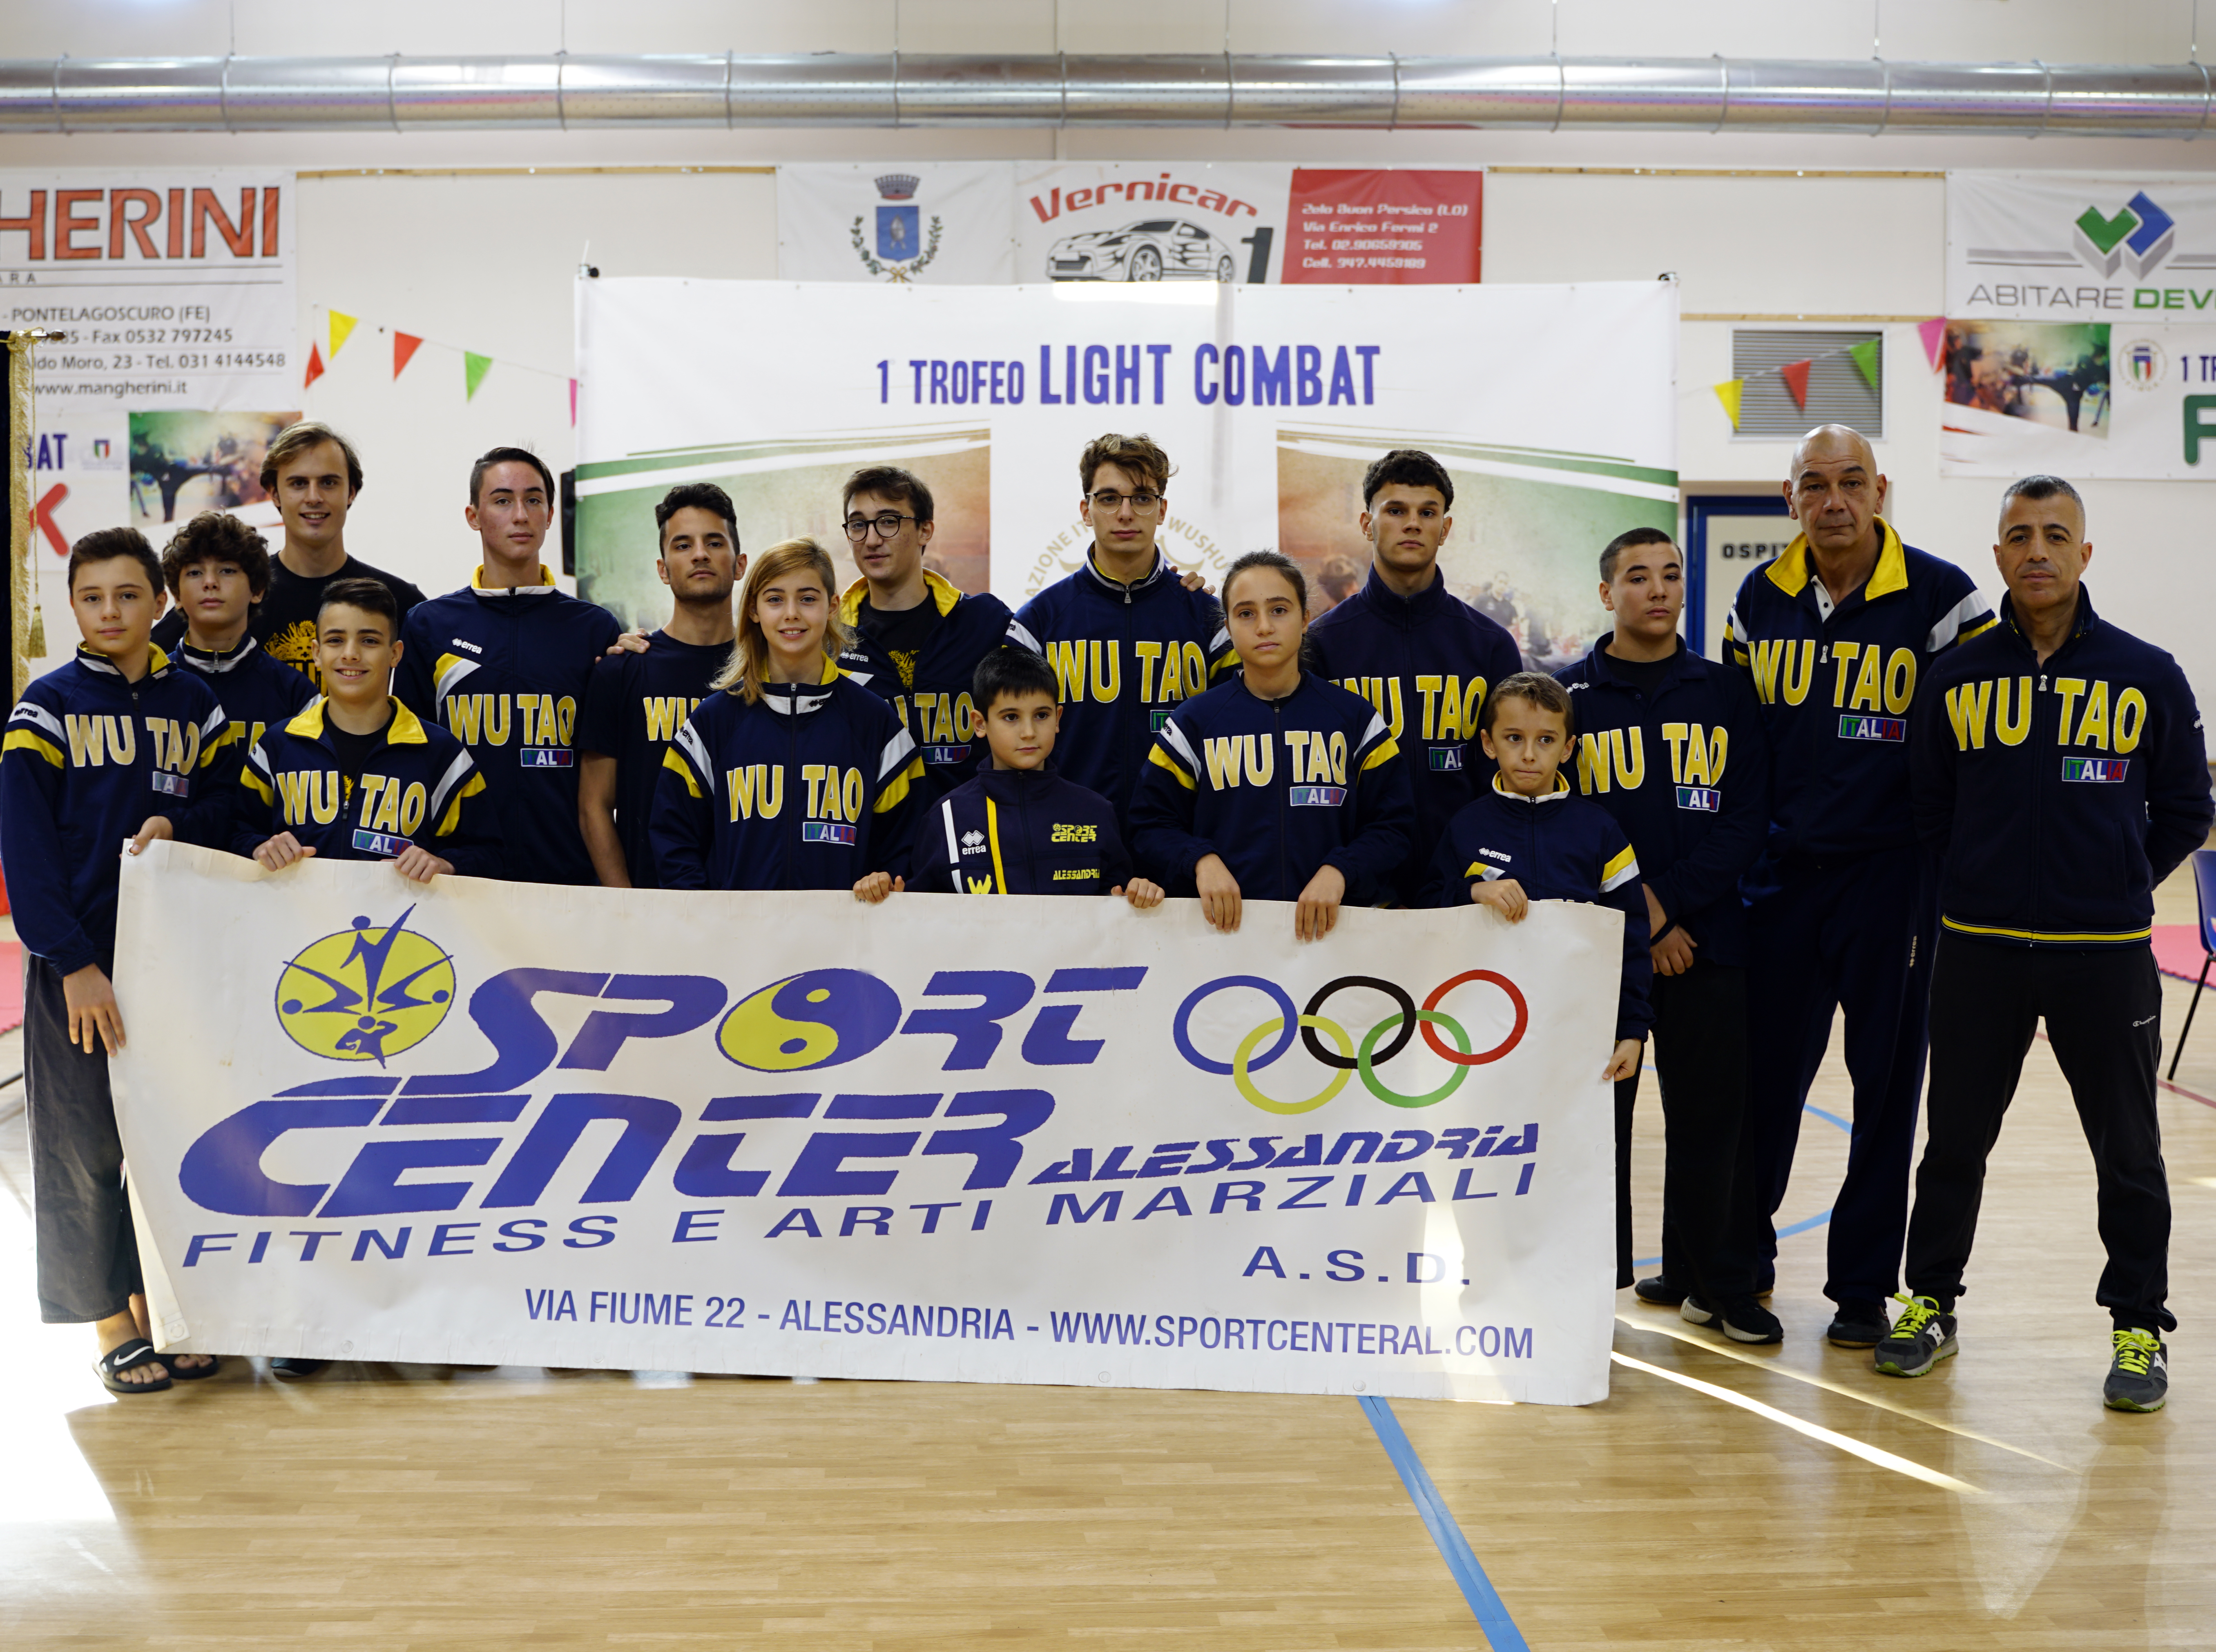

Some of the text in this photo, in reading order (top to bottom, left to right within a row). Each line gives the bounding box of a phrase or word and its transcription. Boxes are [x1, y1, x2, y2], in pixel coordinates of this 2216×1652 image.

[1029, 172, 1257, 223] Vernicar
[1301, 203, 1468, 216] Zelo Buon Persico (LO)
[1303, 221, 1439, 234] Via Enrico Fermi 2
[1303, 239, 1327, 250] Tel.
[0, 270, 36, 285] RA
[1241, 227, 1274, 283] 1
[1302, 257, 1332, 268] Cell.
[11, 306, 174, 322] PONTELAGOSCURO
[179, 305, 211, 324] (FE)
[1966, 284, 2216, 310] ABITARE DEV
[92, 330, 121, 344] Fax
[125, 329, 167, 344] 0532
[172, 328, 233, 343] 797245
[62, 355, 107, 371] Moro,
[112, 354, 133, 368] 23
[147, 354, 174, 369] Tel.
[179, 354, 208, 368] 031
[215, 353, 286, 367] 4144548
[909, 360, 1024, 404] TROFEO
[1040, 344, 1172, 405] LIGHT
[1194, 343, 1380, 406] COMBAT
[1024, 531, 1073, 604] AZIONE
[460, 639, 482, 654] errea
[850, 652, 869, 663] errea
[1046, 640, 1207, 703] WU TAO
[1747, 639, 1917, 715] WU TAO
[446, 693, 577, 747] WU TAO
[914, 691, 975, 743] TAO
[1415, 675, 1488, 740] TAO
[1842, 717, 1901, 740] ITALIA
[1945, 676, 2147, 754] WU TAO
[64, 714, 200, 776] WU TAO
[523, 750, 570, 766] ITALIA
[923, 747, 967, 762] ITALIA
[1203, 730, 1348, 791] WU TAO
[1576, 722, 1728, 796] WU TAO
[2065, 760, 2124, 781] ITALIA
[275, 769, 427, 836] WU TAO
[726, 764, 864, 823] WU TAO
[807, 824, 856, 844] ITALIA
[962, 844, 986, 855] errea
[1489, 849, 1512, 863] errea
[271, 965, 1149, 1098] SPORT
[178, 1088, 1057, 1219] CENTER
[1027, 1122, 1539, 1186] ALESSANDRIA
[183, 1162, 1536, 1268] FITNESS E ARTI MARZIALI
[1242, 1246, 1471, 1286] A.S.D.
[524, 1288, 578, 1322] VIA
[589, 1291, 694, 1327] FIUME
[704, 1296, 745, 1329] 22
[779, 1299, 1015, 1341] ALESSANDRIA
[1050, 1311, 1534, 1359] WWW.SPORTCENTERAL.COM
